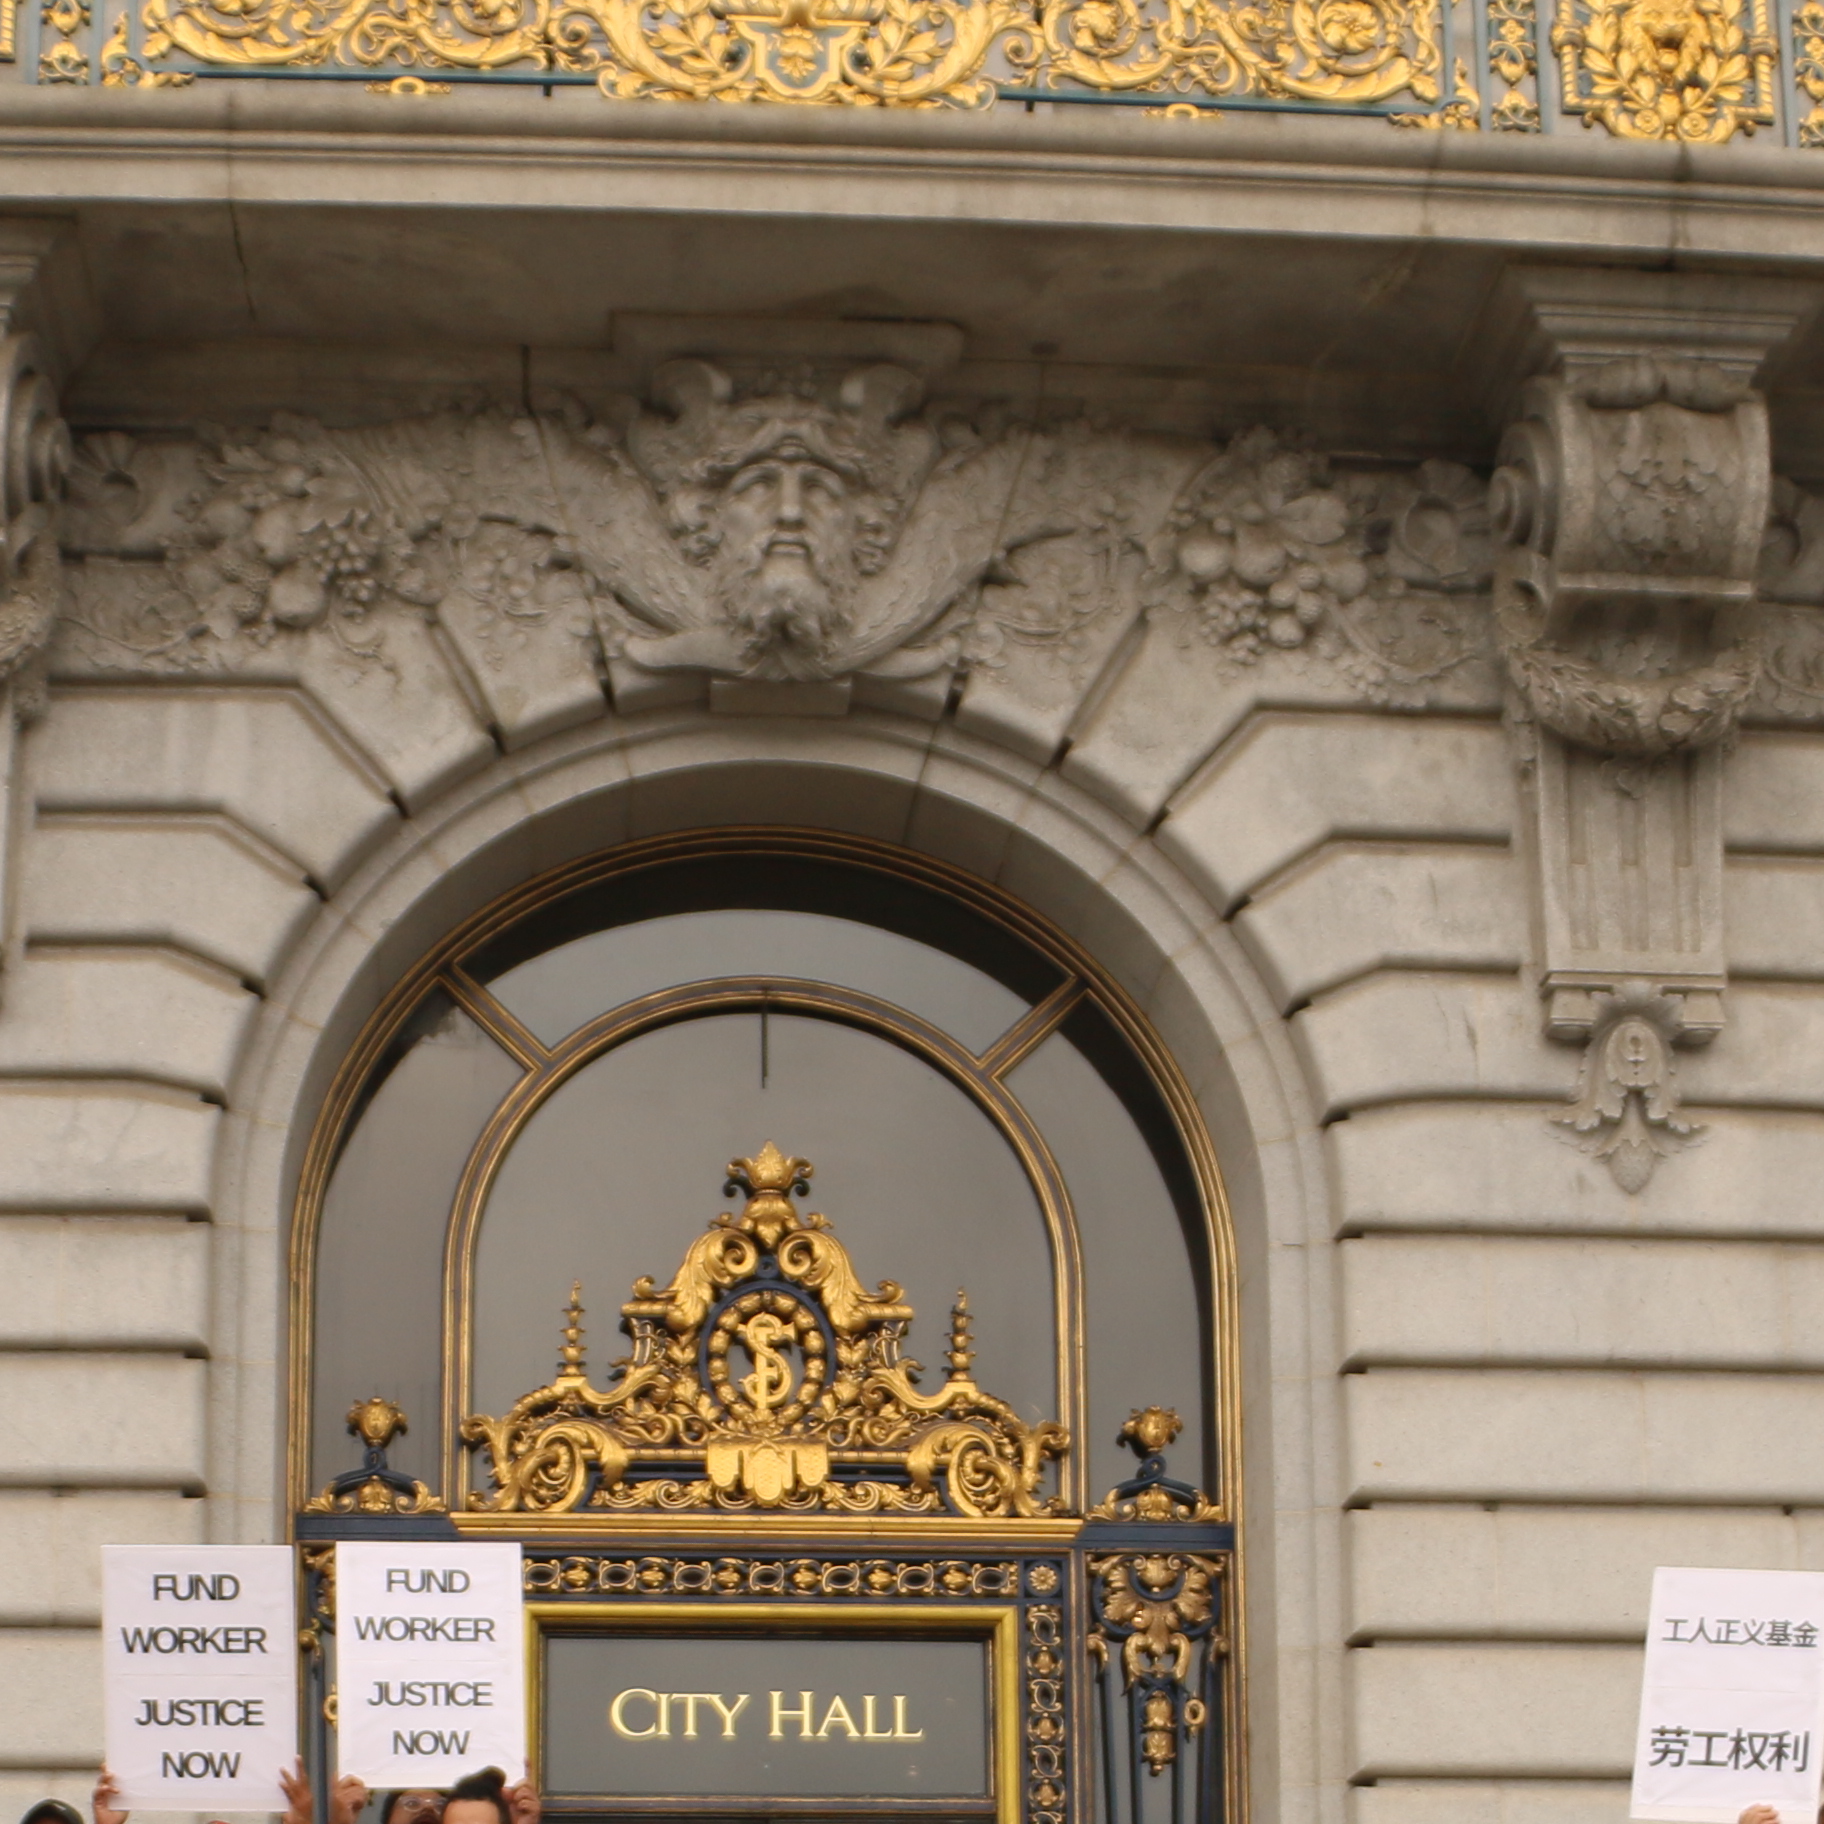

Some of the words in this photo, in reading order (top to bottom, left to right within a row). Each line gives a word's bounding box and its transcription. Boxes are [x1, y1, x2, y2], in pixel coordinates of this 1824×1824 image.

[152, 1573, 241, 1601] FUND
[385, 1567, 471, 1594] FUND
[121, 1626, 268, 1655] WORKER
[353, 1615, 496, 1643] WORKER
[1660, 1617, 1819, 1649] 工人正义基金
[366, 1680, 494, 1708] JUSTICE
[134, 1698, 265, 1727] JUSTICE
[610, 1687, 751, 1739] CITY
[768, 1689, 925, 1740] HALL
[392, 1729, 470, 1756] NOW
[1648, 1725, 1810, 1772] 劳工权利
[161, 1750, 241, 1779] NOW
